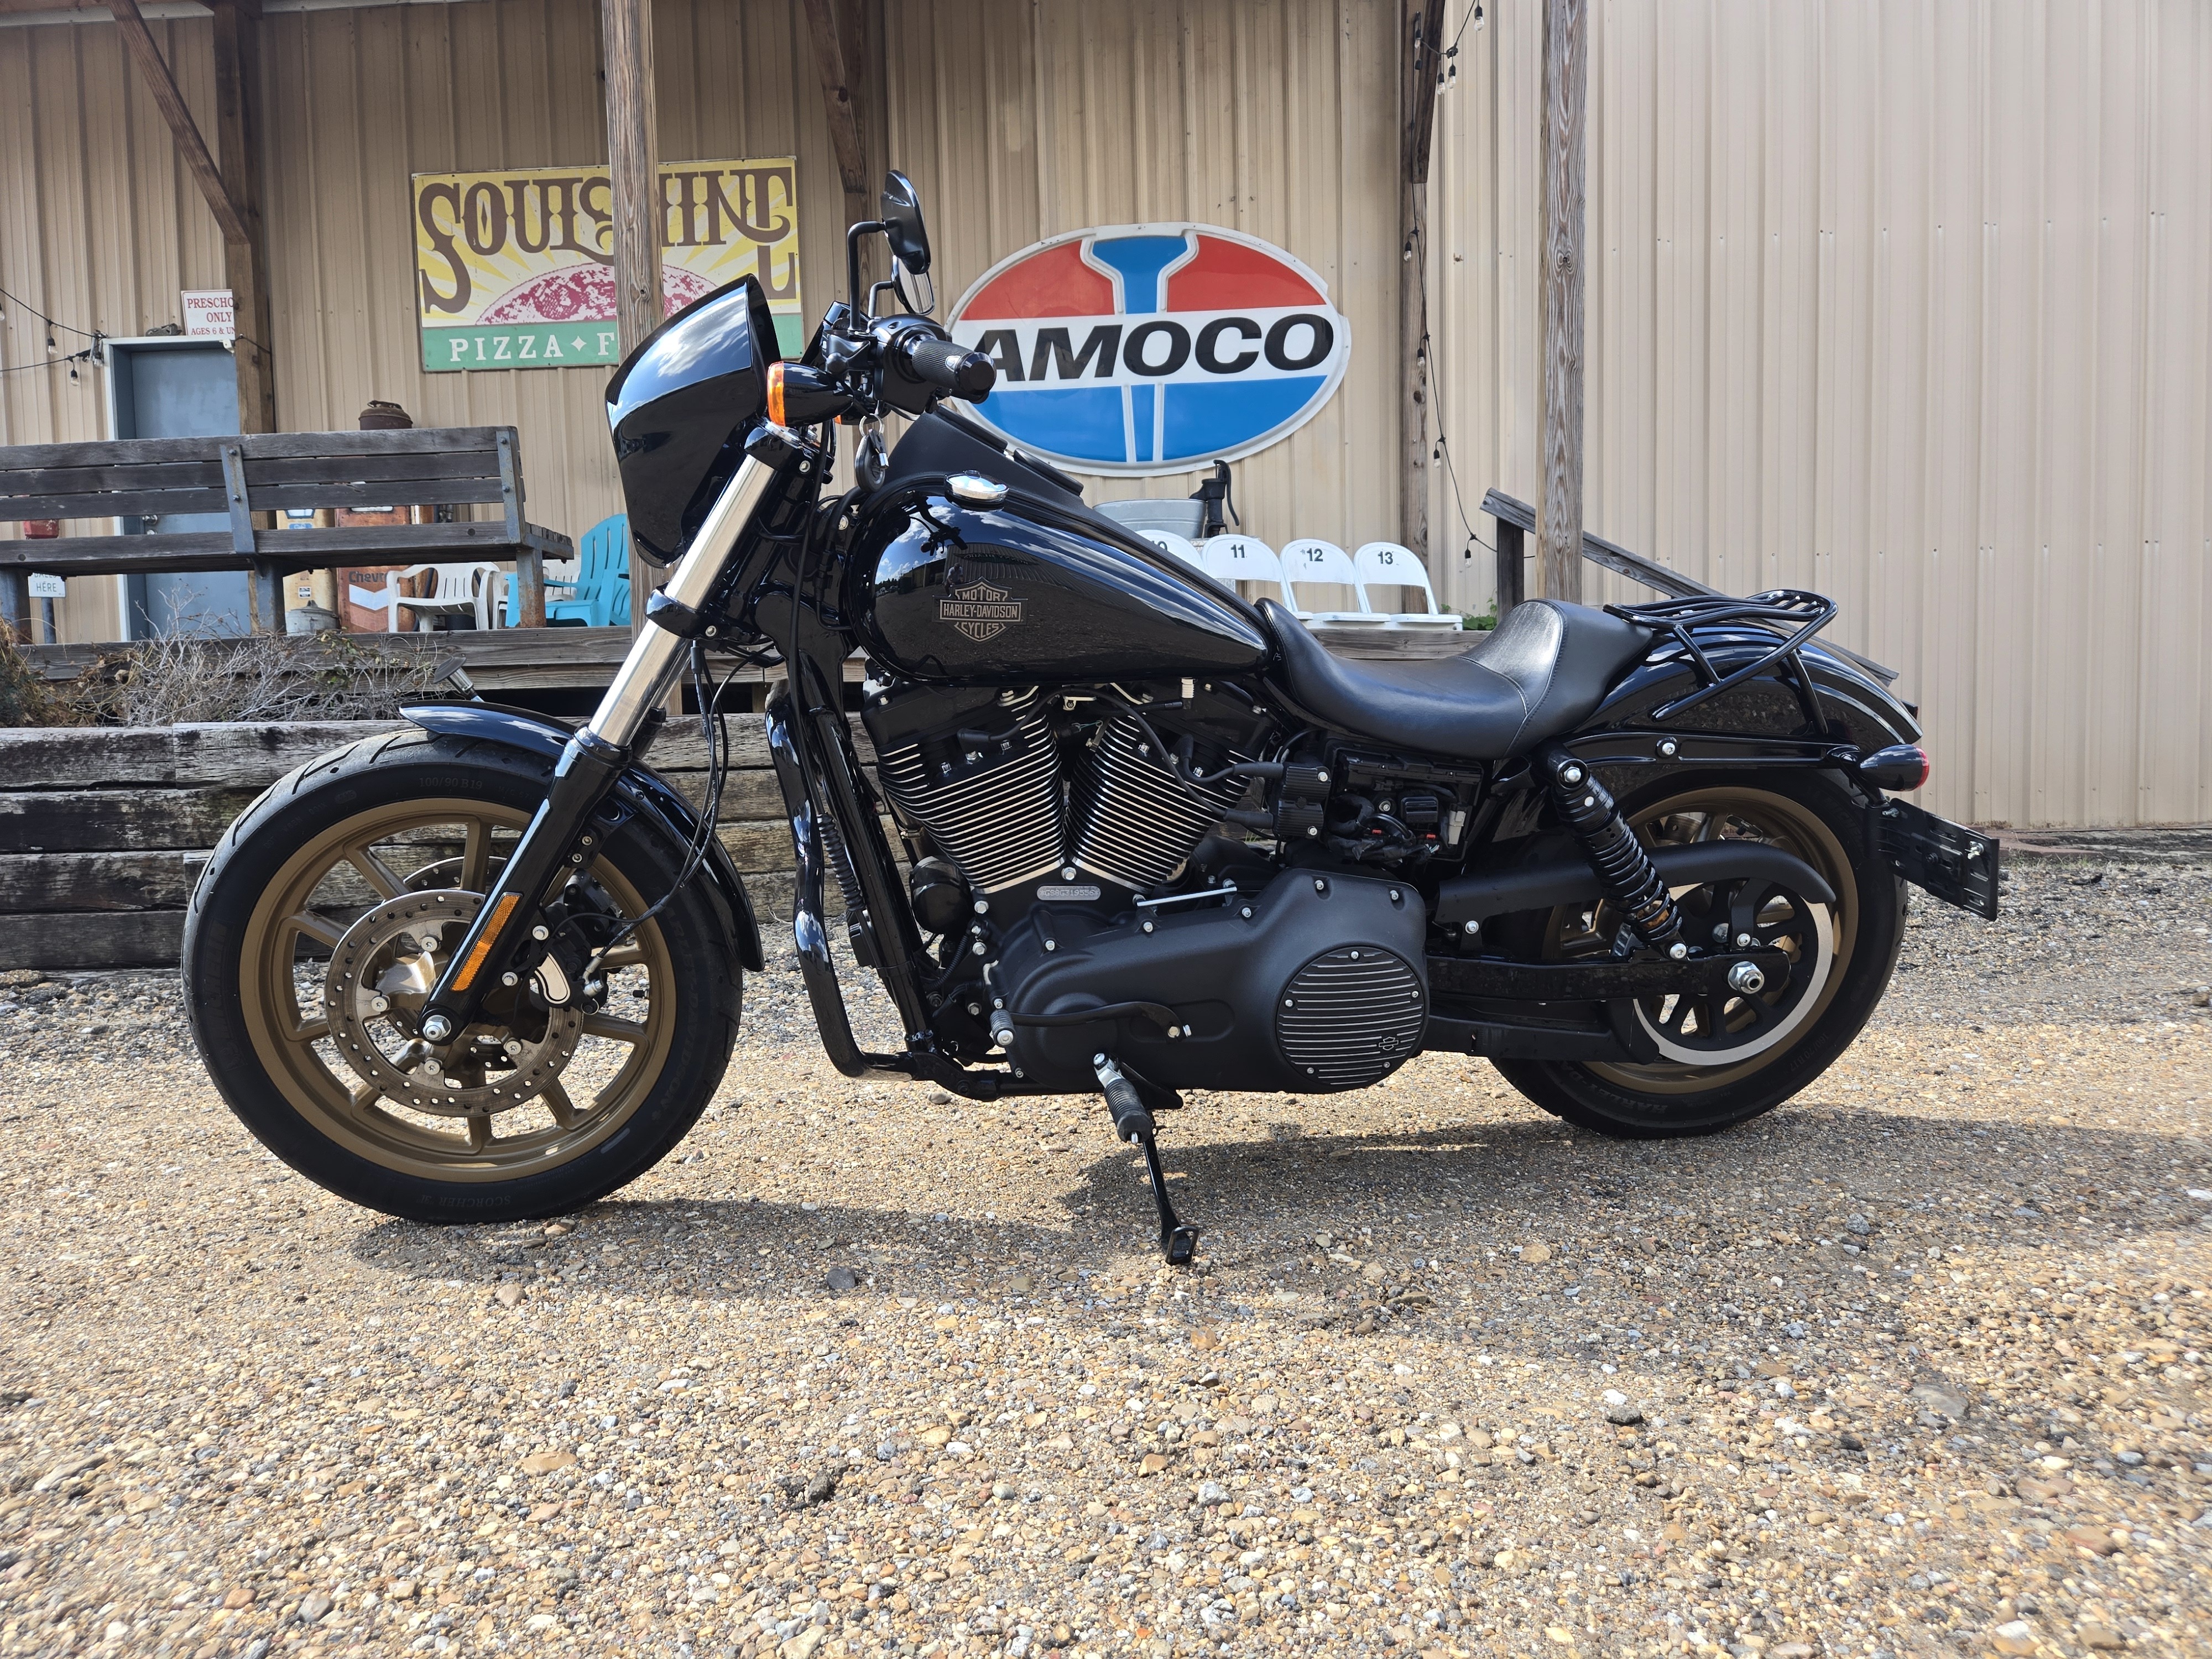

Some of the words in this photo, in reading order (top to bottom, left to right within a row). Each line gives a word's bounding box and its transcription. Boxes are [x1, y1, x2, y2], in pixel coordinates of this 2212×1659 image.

[206, 312, 232, 322] ONLY
[450, 334, 565, 362] PIZZA
[972, 314, 1334, 382] AMOCO
[1230, 544, 1245, 558] 11
[1306, 548, 1323, 562] 12
[1378, 551, 1394, 565] 13
[36, 583, 57, 592] HERE
[962, 586, 1000, 602] MOTOR
[943, 603, 1018, 618] HARLEY-DAVIDSON
[961, 622, 999, 639] CYCLES
[419, 777, 458, 787] 100/90
[439, 1194, 512, 1208] SCORCHER
